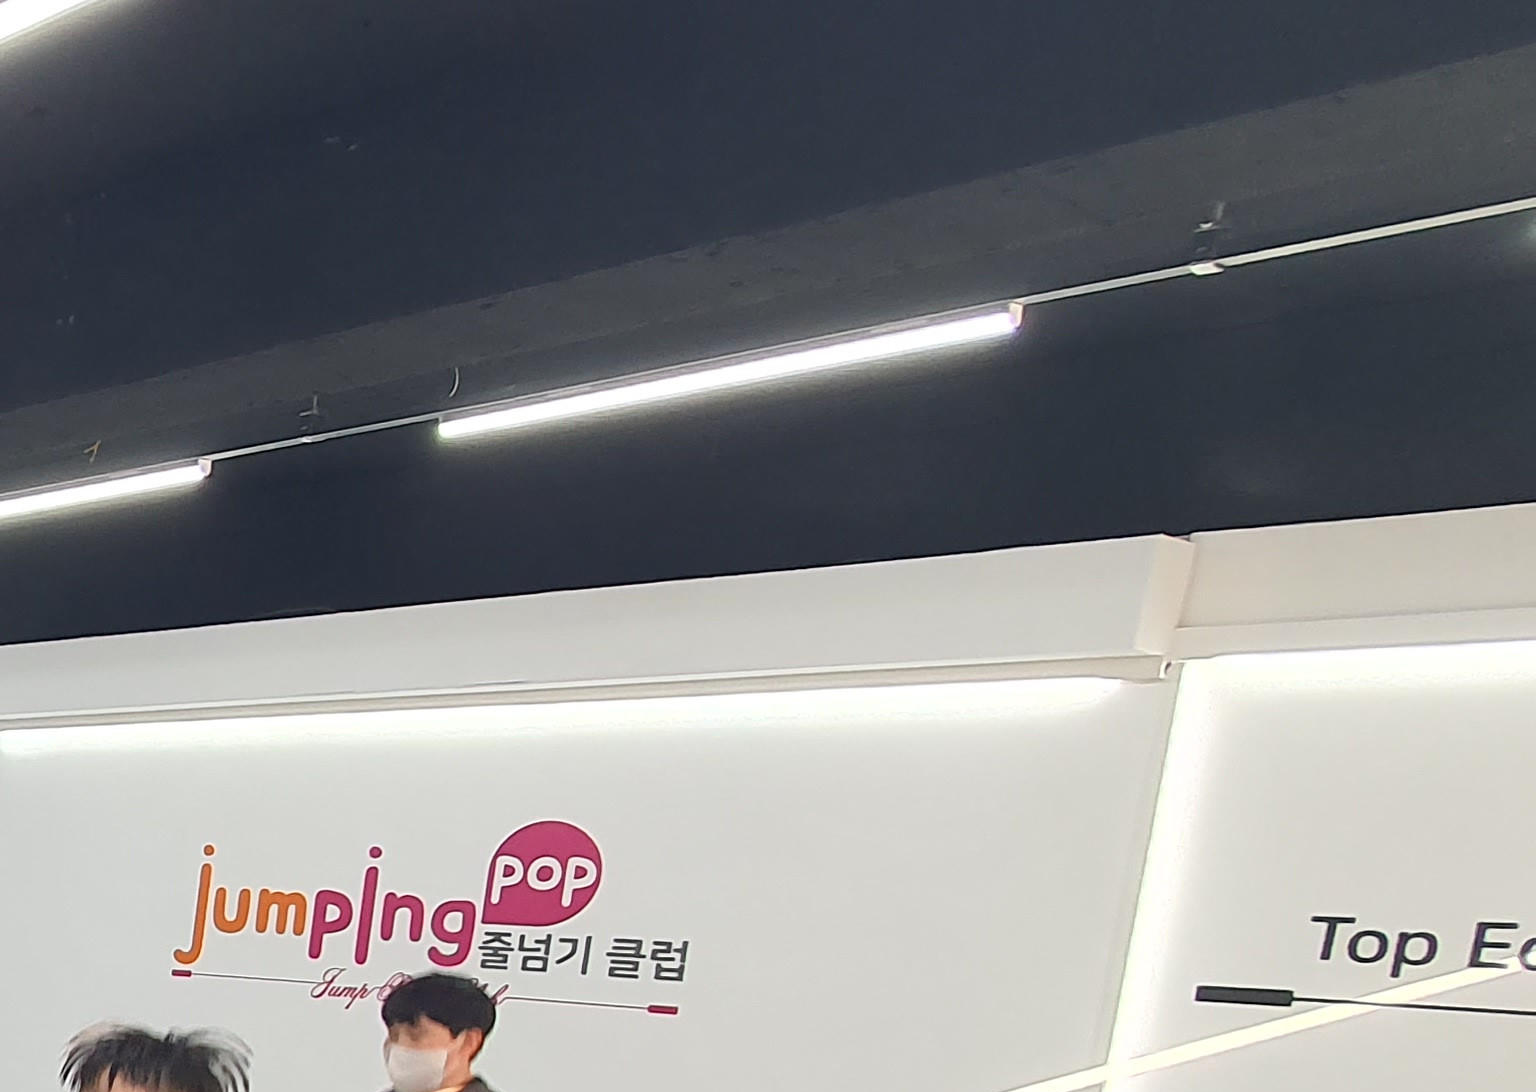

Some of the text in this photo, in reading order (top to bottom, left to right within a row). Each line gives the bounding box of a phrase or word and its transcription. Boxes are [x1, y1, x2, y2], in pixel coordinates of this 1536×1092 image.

[174, 844, 476, 967] jumping
[490, 854, 599, 907] POP
[477, 931, 690, 982] 줄넘기 클럽
[1310, 915, 1438, 978] Top
